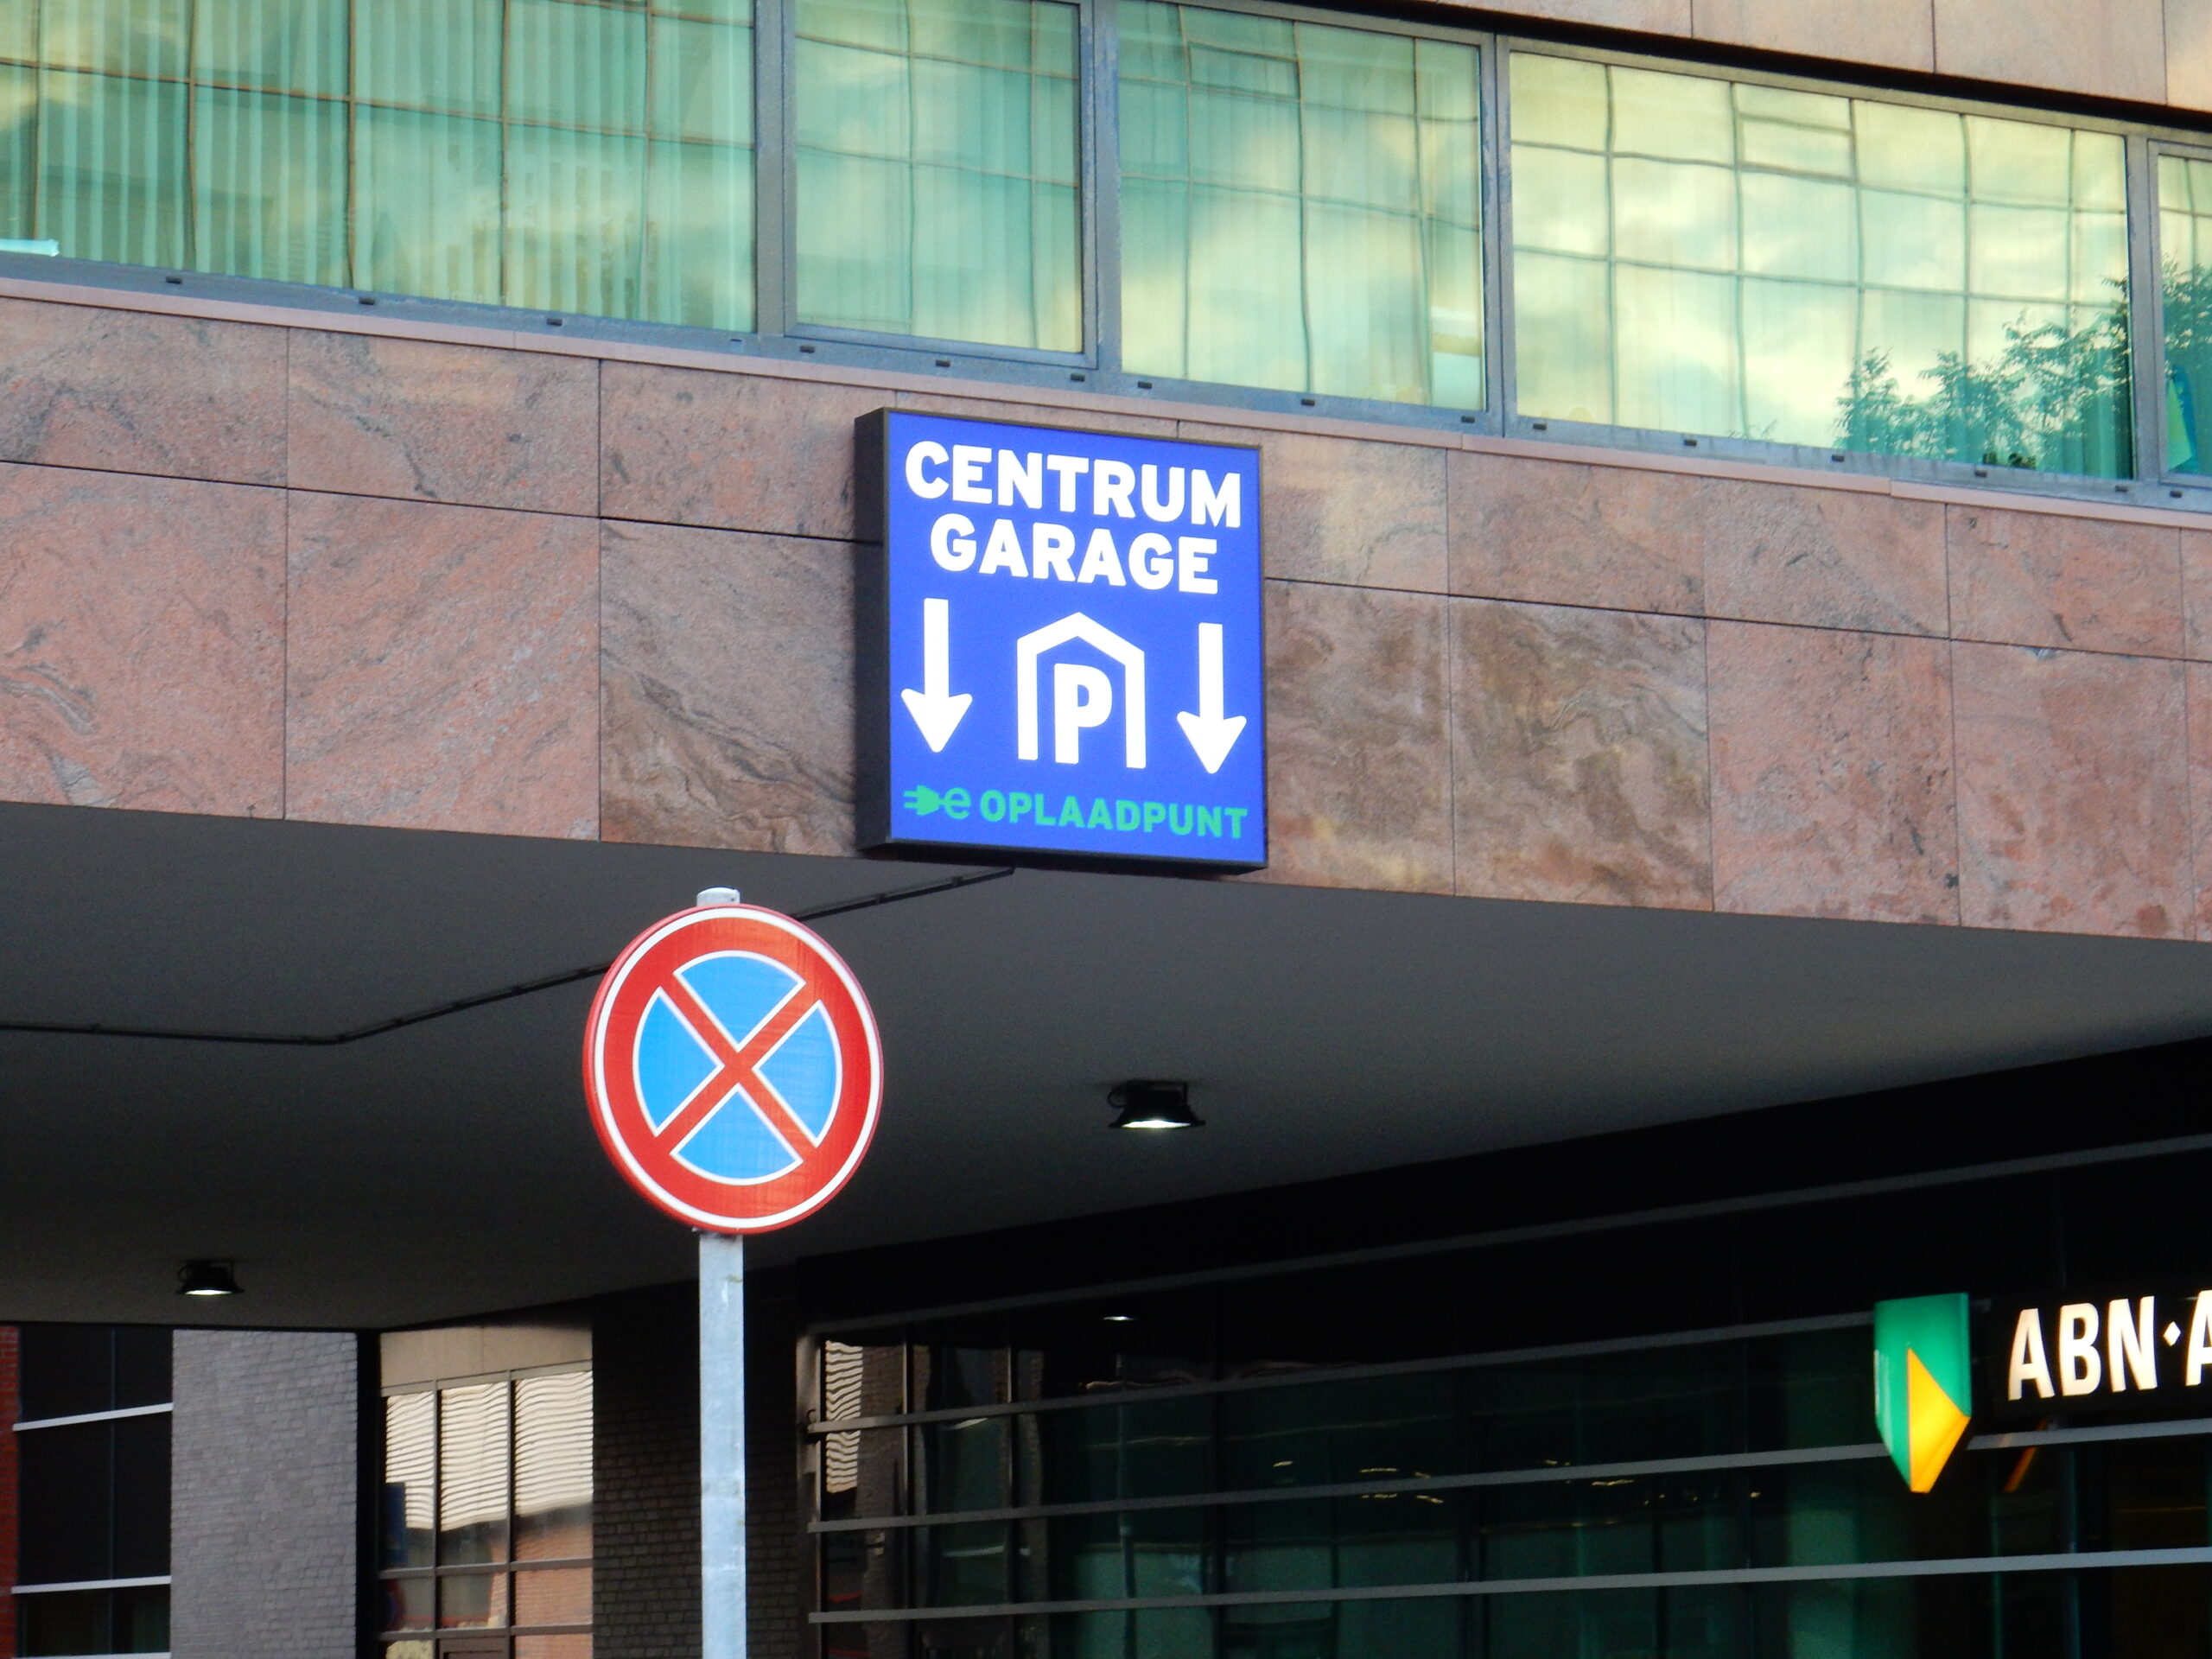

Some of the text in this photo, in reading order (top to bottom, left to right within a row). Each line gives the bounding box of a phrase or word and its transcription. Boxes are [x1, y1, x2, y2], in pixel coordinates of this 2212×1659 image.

[905, 441, 1241, 529] CENTRUM
[930, 512, 1218, 595] GARAGE
[1053, 663, 1113, 765] P
[979, 789, 1249, 840] OPLAADPUNT
